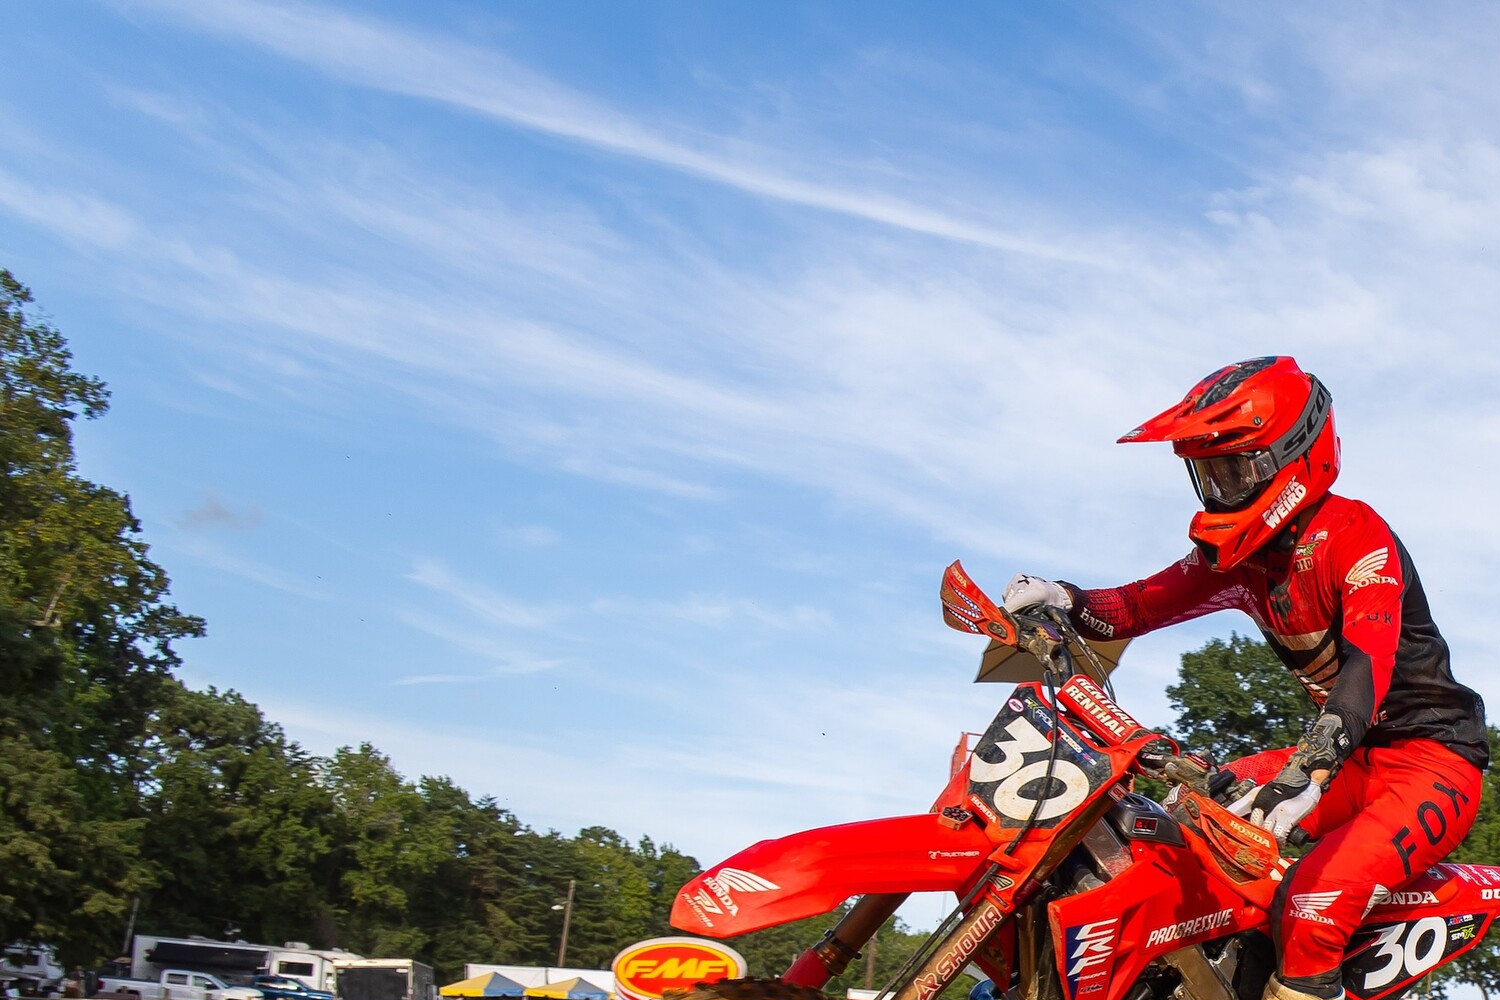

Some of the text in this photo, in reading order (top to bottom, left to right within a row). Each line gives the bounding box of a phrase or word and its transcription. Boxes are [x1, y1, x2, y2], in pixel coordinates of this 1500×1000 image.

[1264, 484, 1307, 530] WEIRD
[1348, 575, 1399, 595] HONDA
[1065, 684, 1127, 738] RENTHAL
[1075, 677, 1138, 728] RENTHAL
[969, 715, 1090, 821] 30
[970, 796, 997, 824] HONDA
[1391, 781, 1470, 878] FOX
[1229, 819, 1271, 848] HONDA
[702, 876, 739, 917] HONDA
[1379, 890, 1440, 905] ONDA
[1145, 908, 1234, 949] PROGRESSIVE
[1288, 909, 1335, 926] HONDA
[1450, 926, 1476, 940] SMX
[936, 904, 1003, 982] SHOWA
[1066, 917, 1119, 977] CRF
[1363, 916, 1448, 990] 30
[625, 957, 728, 979] FMF
